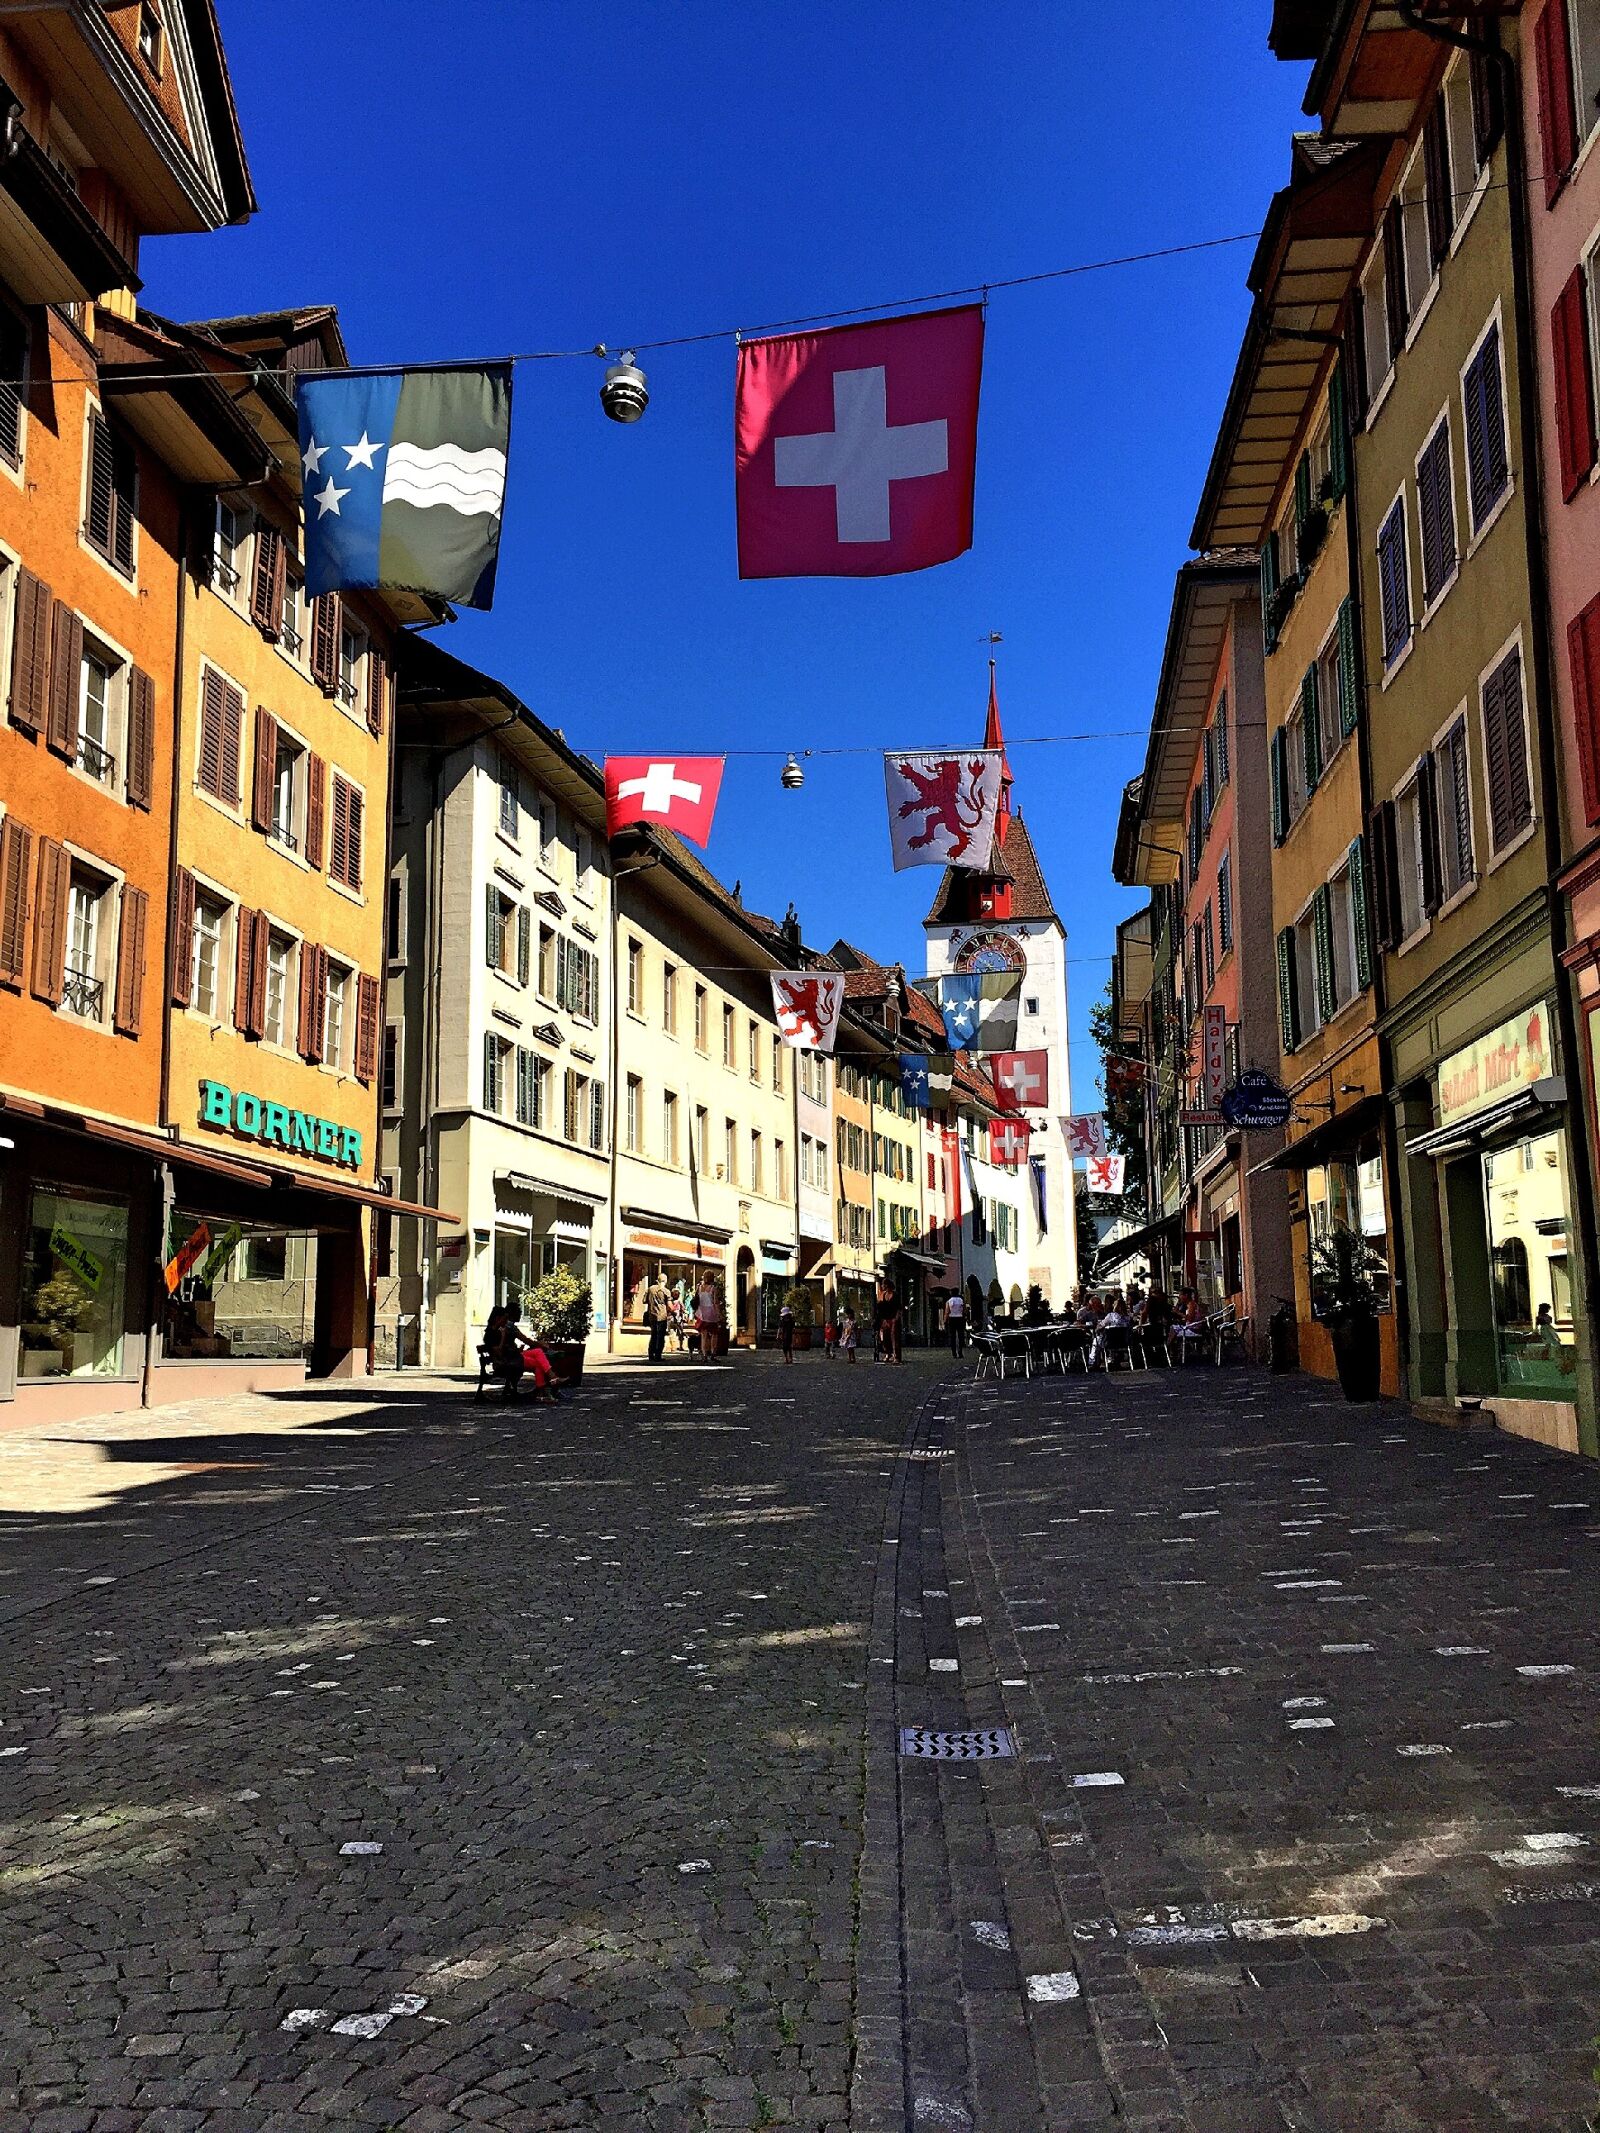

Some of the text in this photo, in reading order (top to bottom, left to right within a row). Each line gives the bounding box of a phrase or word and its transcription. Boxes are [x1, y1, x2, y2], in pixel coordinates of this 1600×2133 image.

[1241, 1075, 1268, 1086] Café
[199, 1079, 363, 1166] BORNER
[1182, 1113, 1222, 1122] Restau
[1232, 1113, 1284, 1127] Schwager
